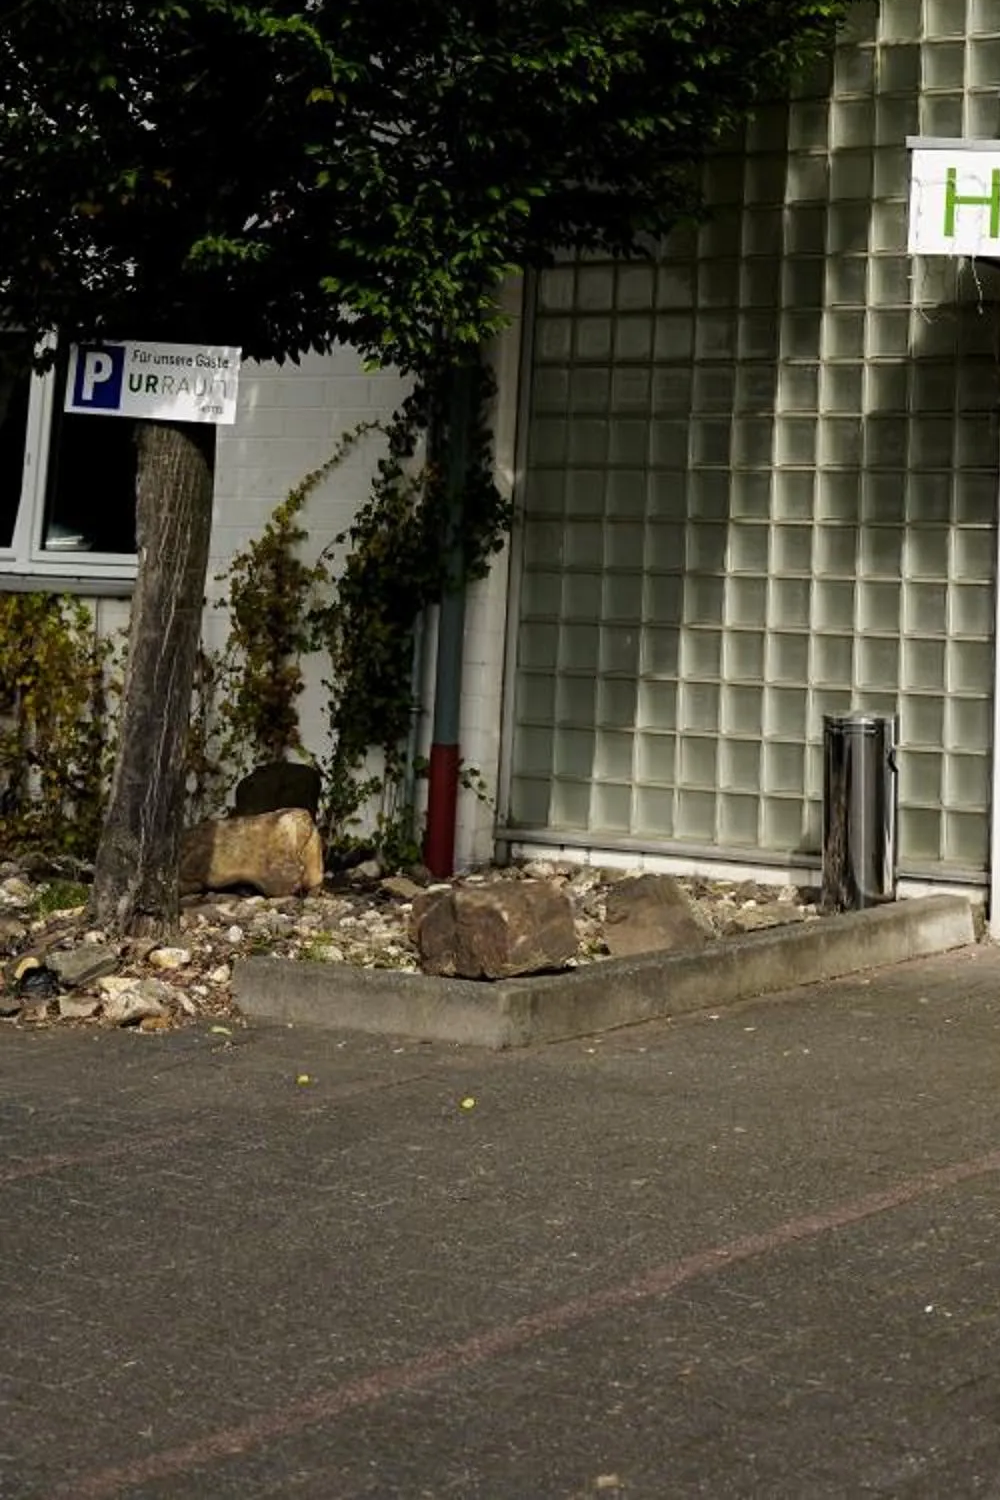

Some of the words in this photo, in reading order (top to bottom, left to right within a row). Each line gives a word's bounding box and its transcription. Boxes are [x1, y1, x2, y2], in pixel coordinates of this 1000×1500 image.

[81, 351, 113, 400] P
[132, 349, 152, 363] Für
[153, 355, 193, 367] unsere
[195, 353, 229, 369] Gäste
